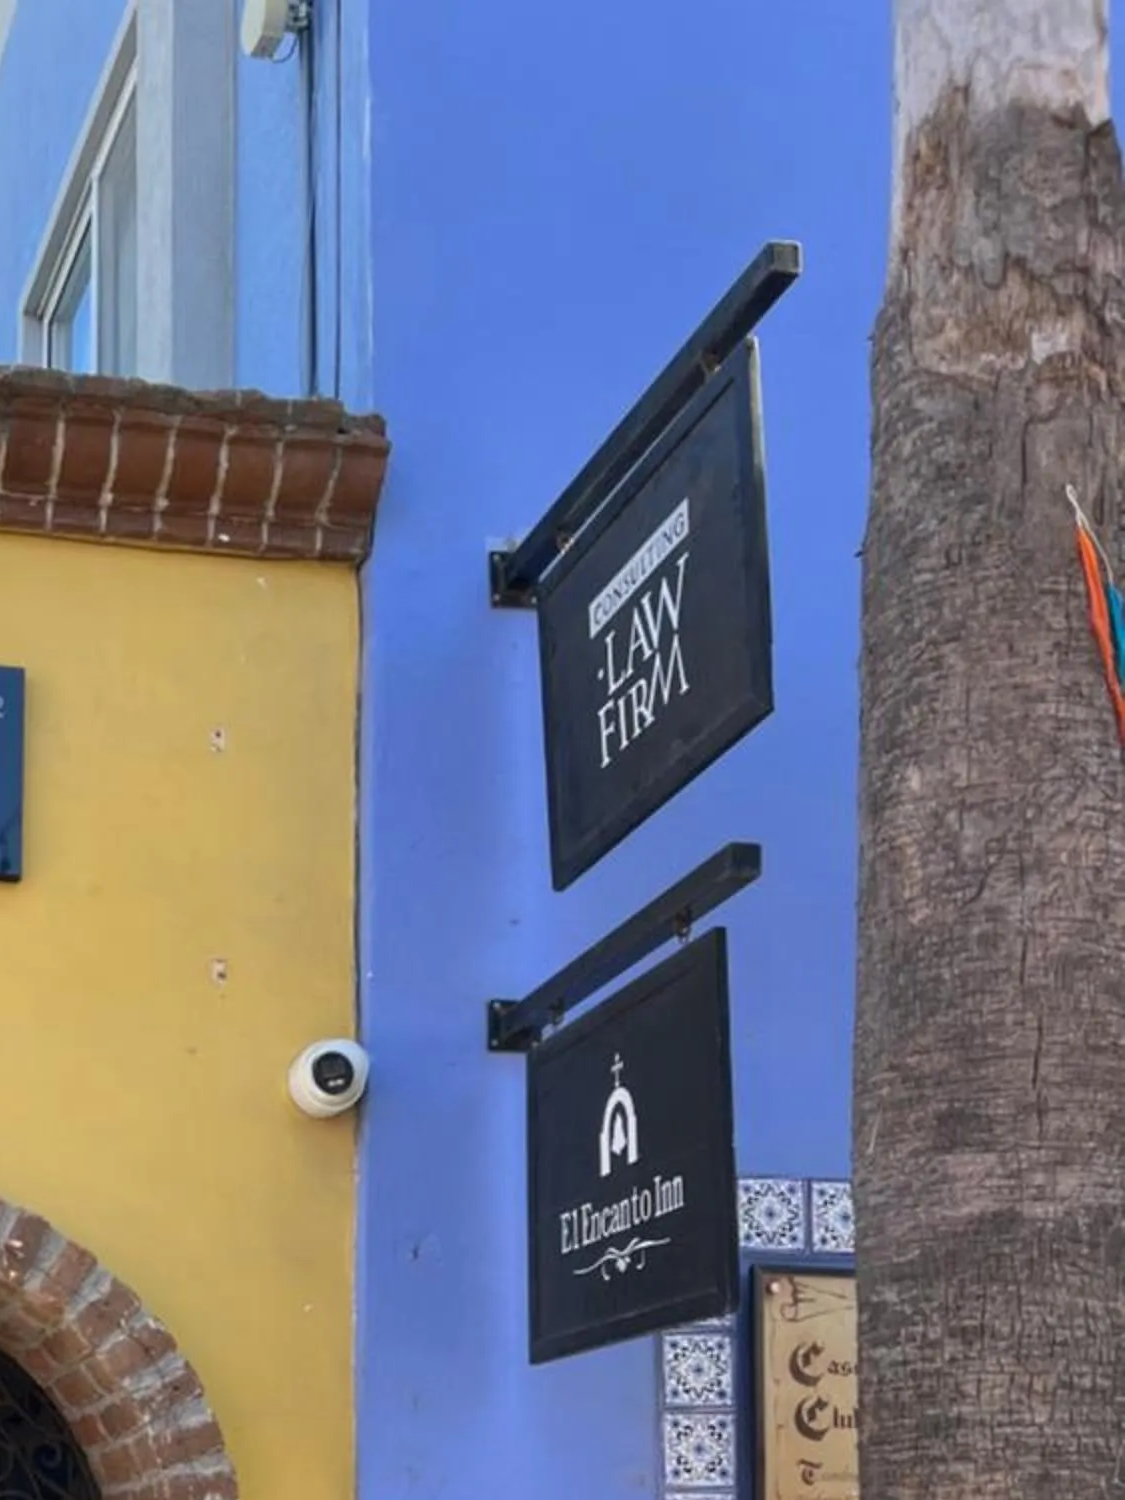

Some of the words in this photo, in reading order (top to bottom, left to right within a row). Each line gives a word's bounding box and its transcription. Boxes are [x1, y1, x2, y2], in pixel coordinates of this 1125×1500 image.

[593, 512, 685, 625] CONSULTING
[603, 553, 690, 696] LAW
[597, 634, 690, 769] FIRM
[559, 1208, 579, 1255] El
[581, 1187, 651, 1250] Encanto
[653, 1175, 684, 1218] Inn
[789, 1341, 857, 1387] Cas
